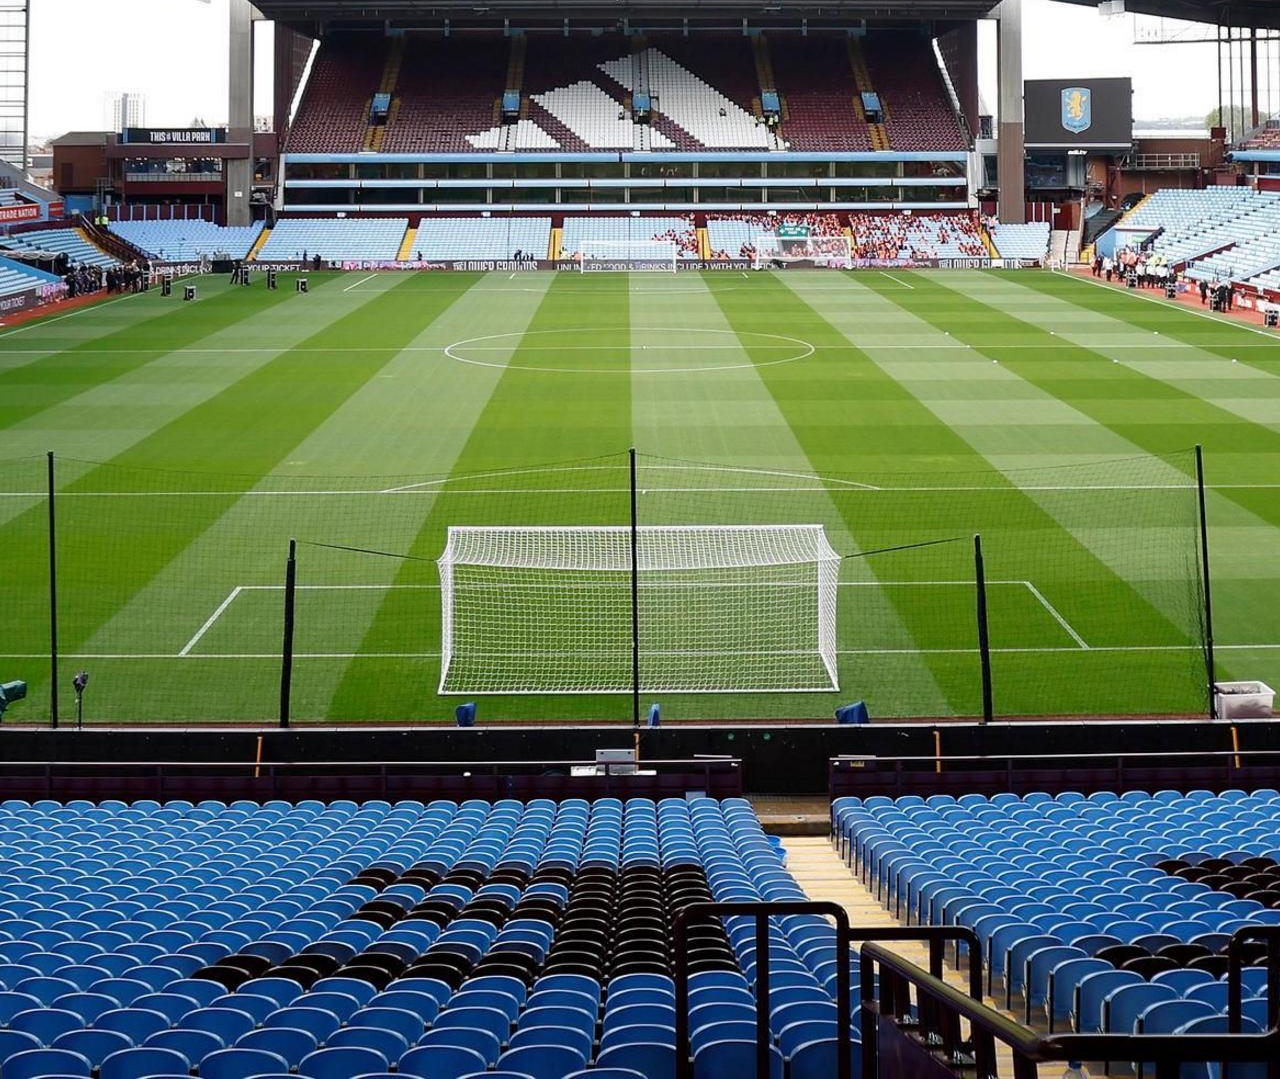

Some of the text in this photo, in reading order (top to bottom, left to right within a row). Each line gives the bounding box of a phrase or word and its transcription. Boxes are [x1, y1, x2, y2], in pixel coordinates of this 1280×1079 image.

[150, 131, 166, 142] THIS
[172, 131, 191, 142] VILLA
[191, 131, 211, 142] PARK
